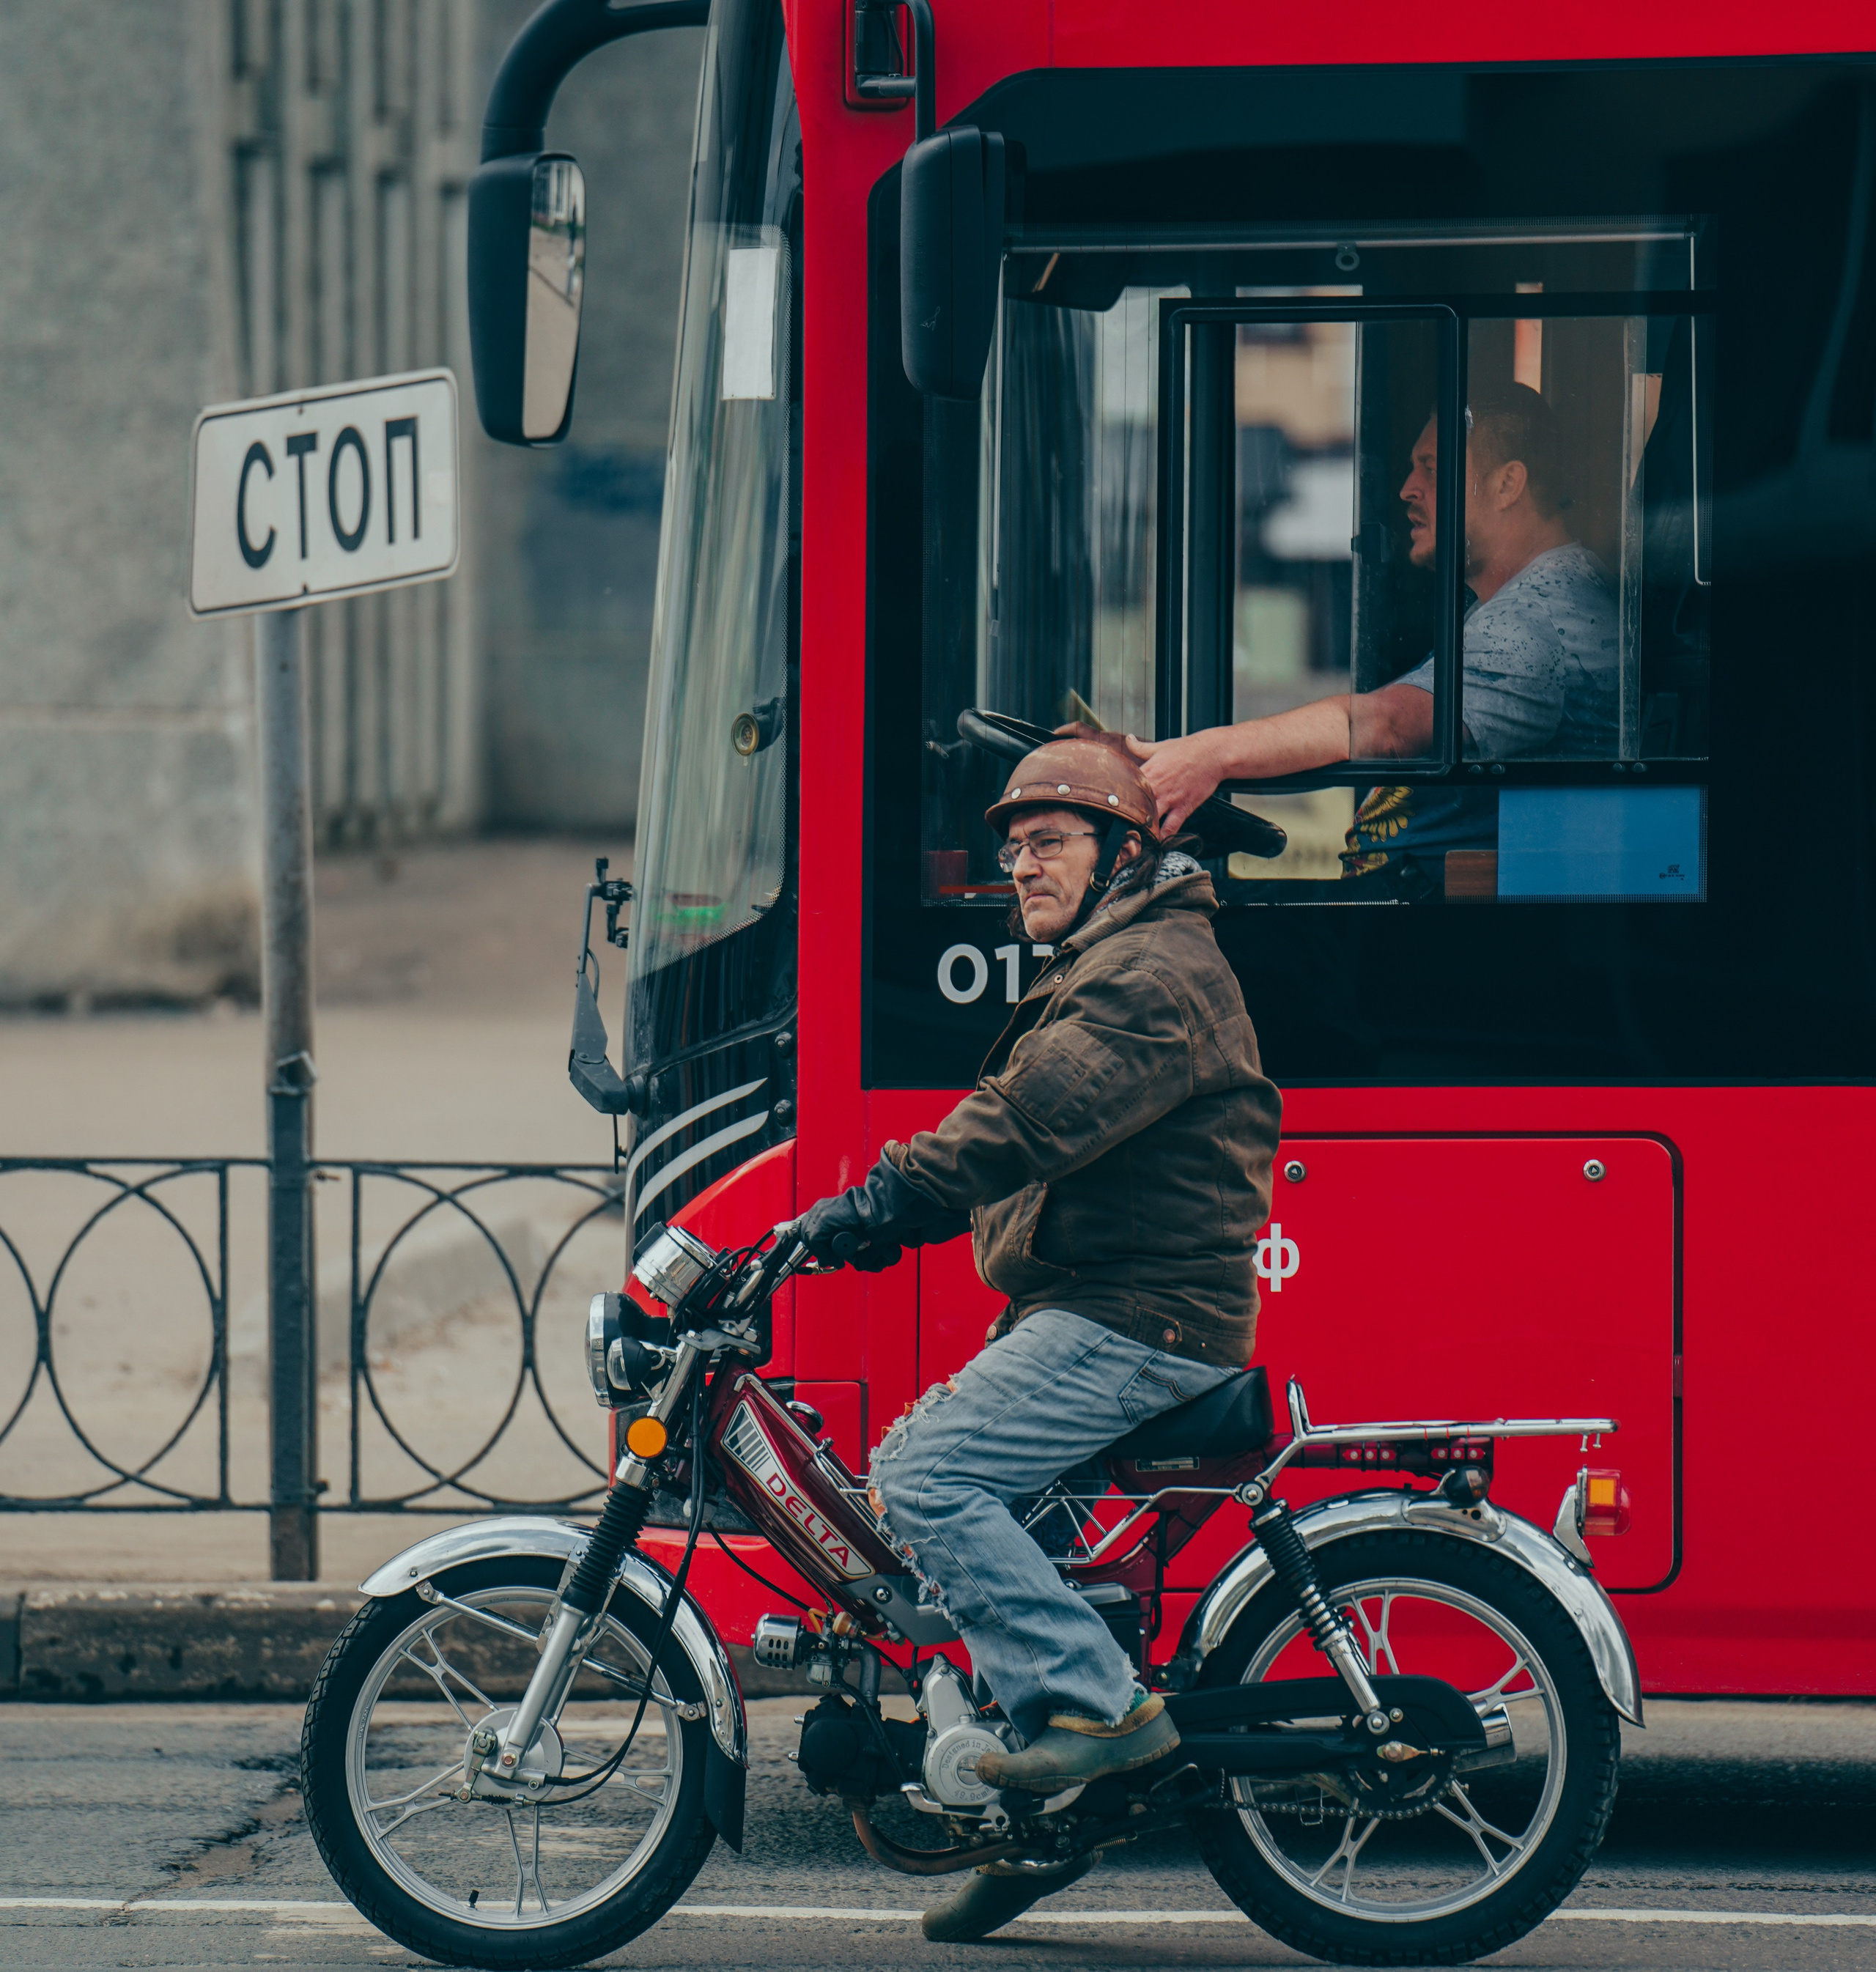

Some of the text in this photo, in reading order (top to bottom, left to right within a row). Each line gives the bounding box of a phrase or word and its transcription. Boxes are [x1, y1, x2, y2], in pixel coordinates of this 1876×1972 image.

[237, 416, 420, 569] СТОП
[937, 943, 1054, 1004] 01
[766, 1472, 850, 1568] DELTA
[942, 1740, 970, 1769] Designed
[972, 1740, 981, 1748] in
